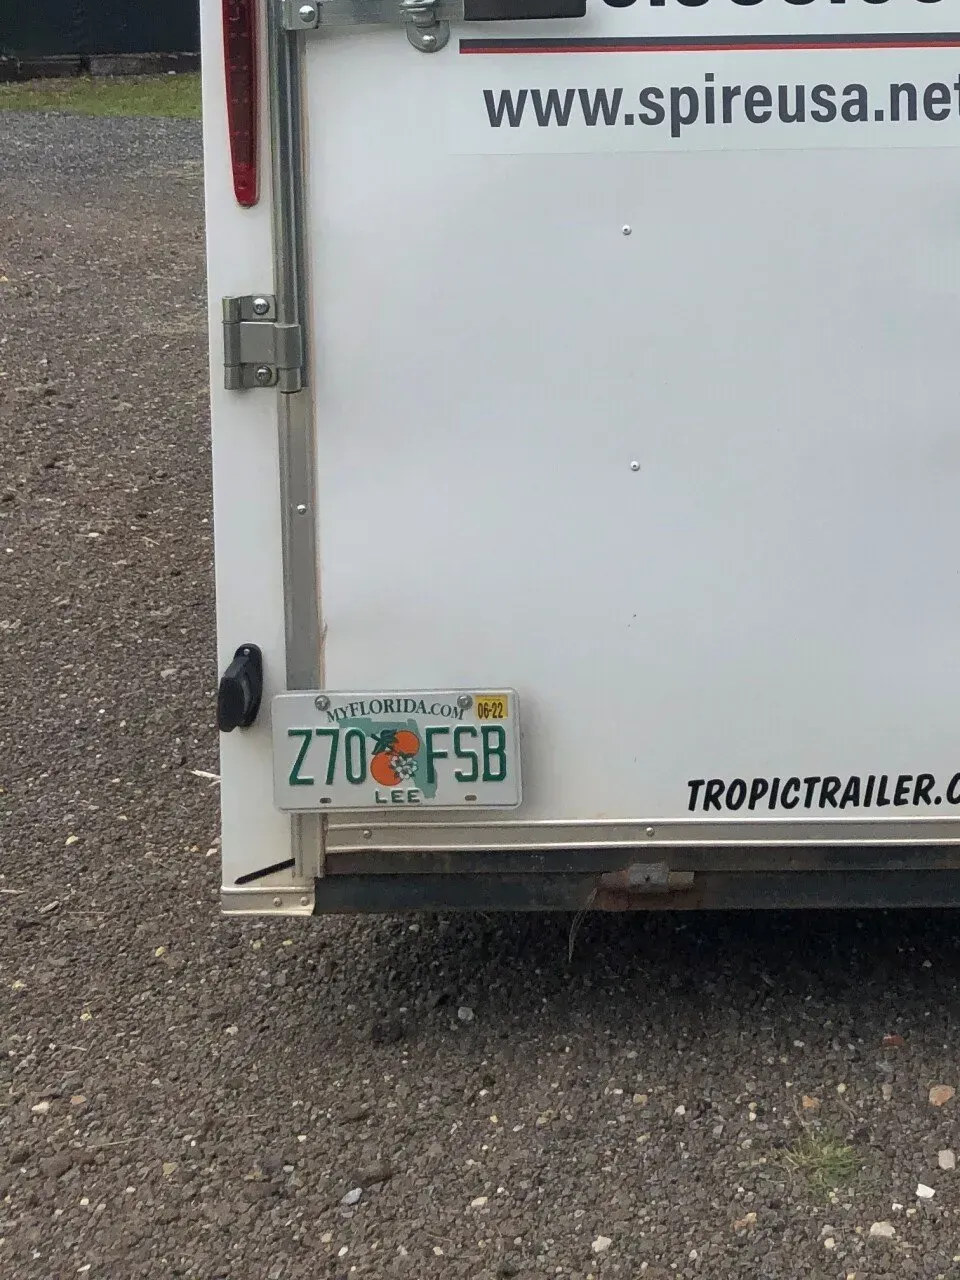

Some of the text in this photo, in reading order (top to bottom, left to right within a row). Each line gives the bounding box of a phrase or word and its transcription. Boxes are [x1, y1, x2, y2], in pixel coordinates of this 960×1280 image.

[326, 699, 464, 723] MYFLORIDA.COM
[478, 702, 503, 719] 06-22
[288, 725, 506, 786] Z70 FSB
[375, 789, 421, 804] LEE
